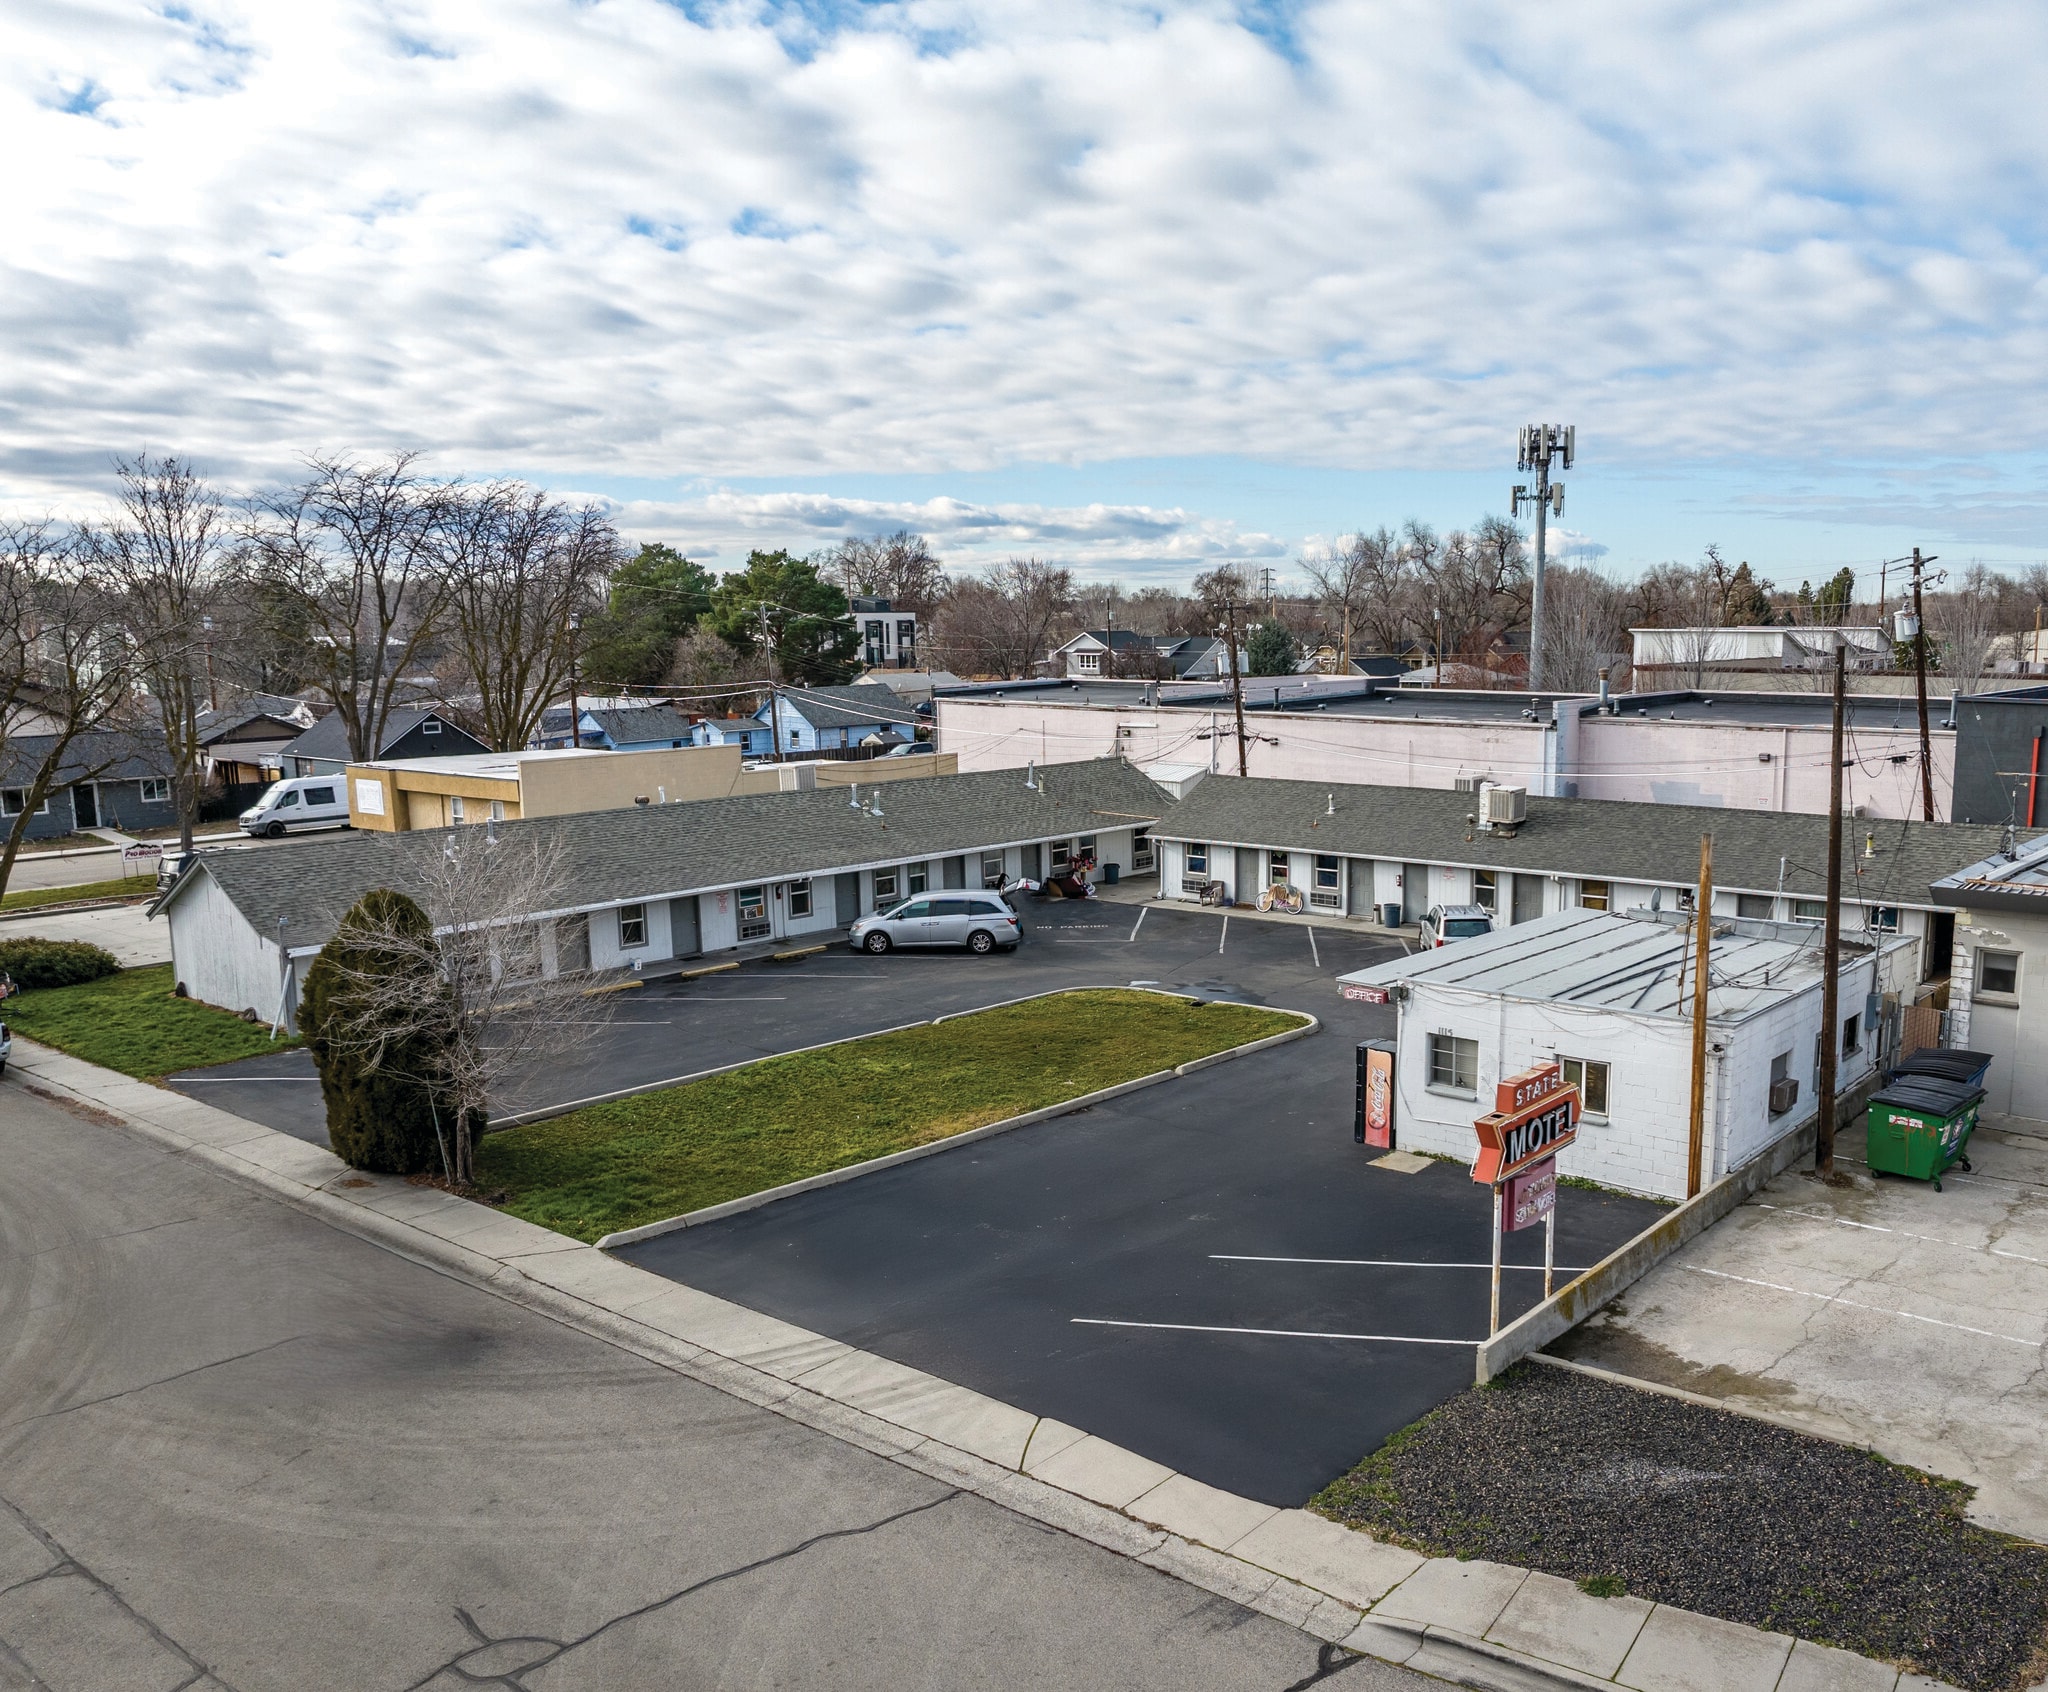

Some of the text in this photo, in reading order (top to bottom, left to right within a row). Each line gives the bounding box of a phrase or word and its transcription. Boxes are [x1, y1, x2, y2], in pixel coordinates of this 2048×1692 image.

[1345, 989, 1383, 1003] OFFICE
[1516, 1071, 1559, 1106] STATE
[1508, 1101, 1579, 1164] MOTEL
